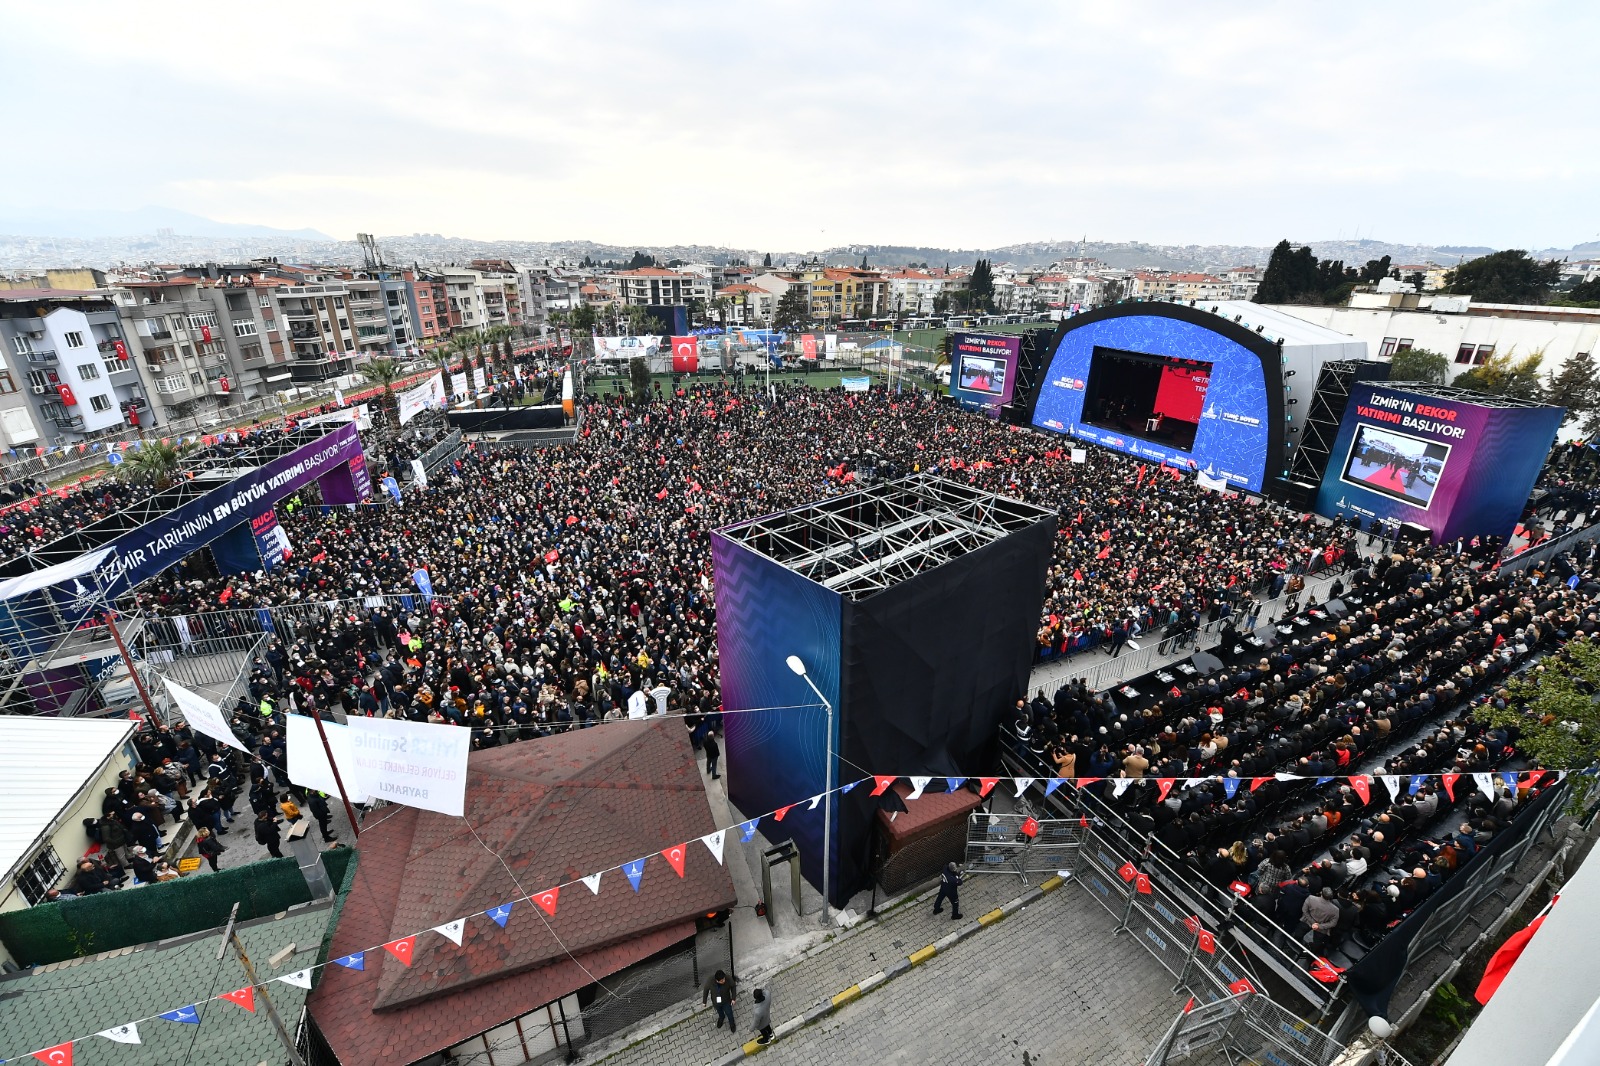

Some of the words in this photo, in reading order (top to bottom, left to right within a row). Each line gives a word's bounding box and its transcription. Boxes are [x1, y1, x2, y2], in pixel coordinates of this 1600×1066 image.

[982, 347, 1012, 356] BAŞLIYOR!
[1370, 393, 1414, 412] İZMİR'İN
[1415, 404, 1458, 421] REKOR
[1356, 406, 1402, 424] YATIRIMI
[1402, 416, 1465, 439] BAŞLIYOR!
[100, 550, 147, 584] İZMİR
[146, 512, 214, 557] TARİHİNİN
[214, 504, 231, 521] EN
[231, 484, 268, 516] BÜYÜK
[266, 462, 305, 490] YATIRIMI
[304, 444, 339, 470] BAŞLIYOR
[252, 510, 275, 529] BUCA
[261, 530, 274, 542] TEME
